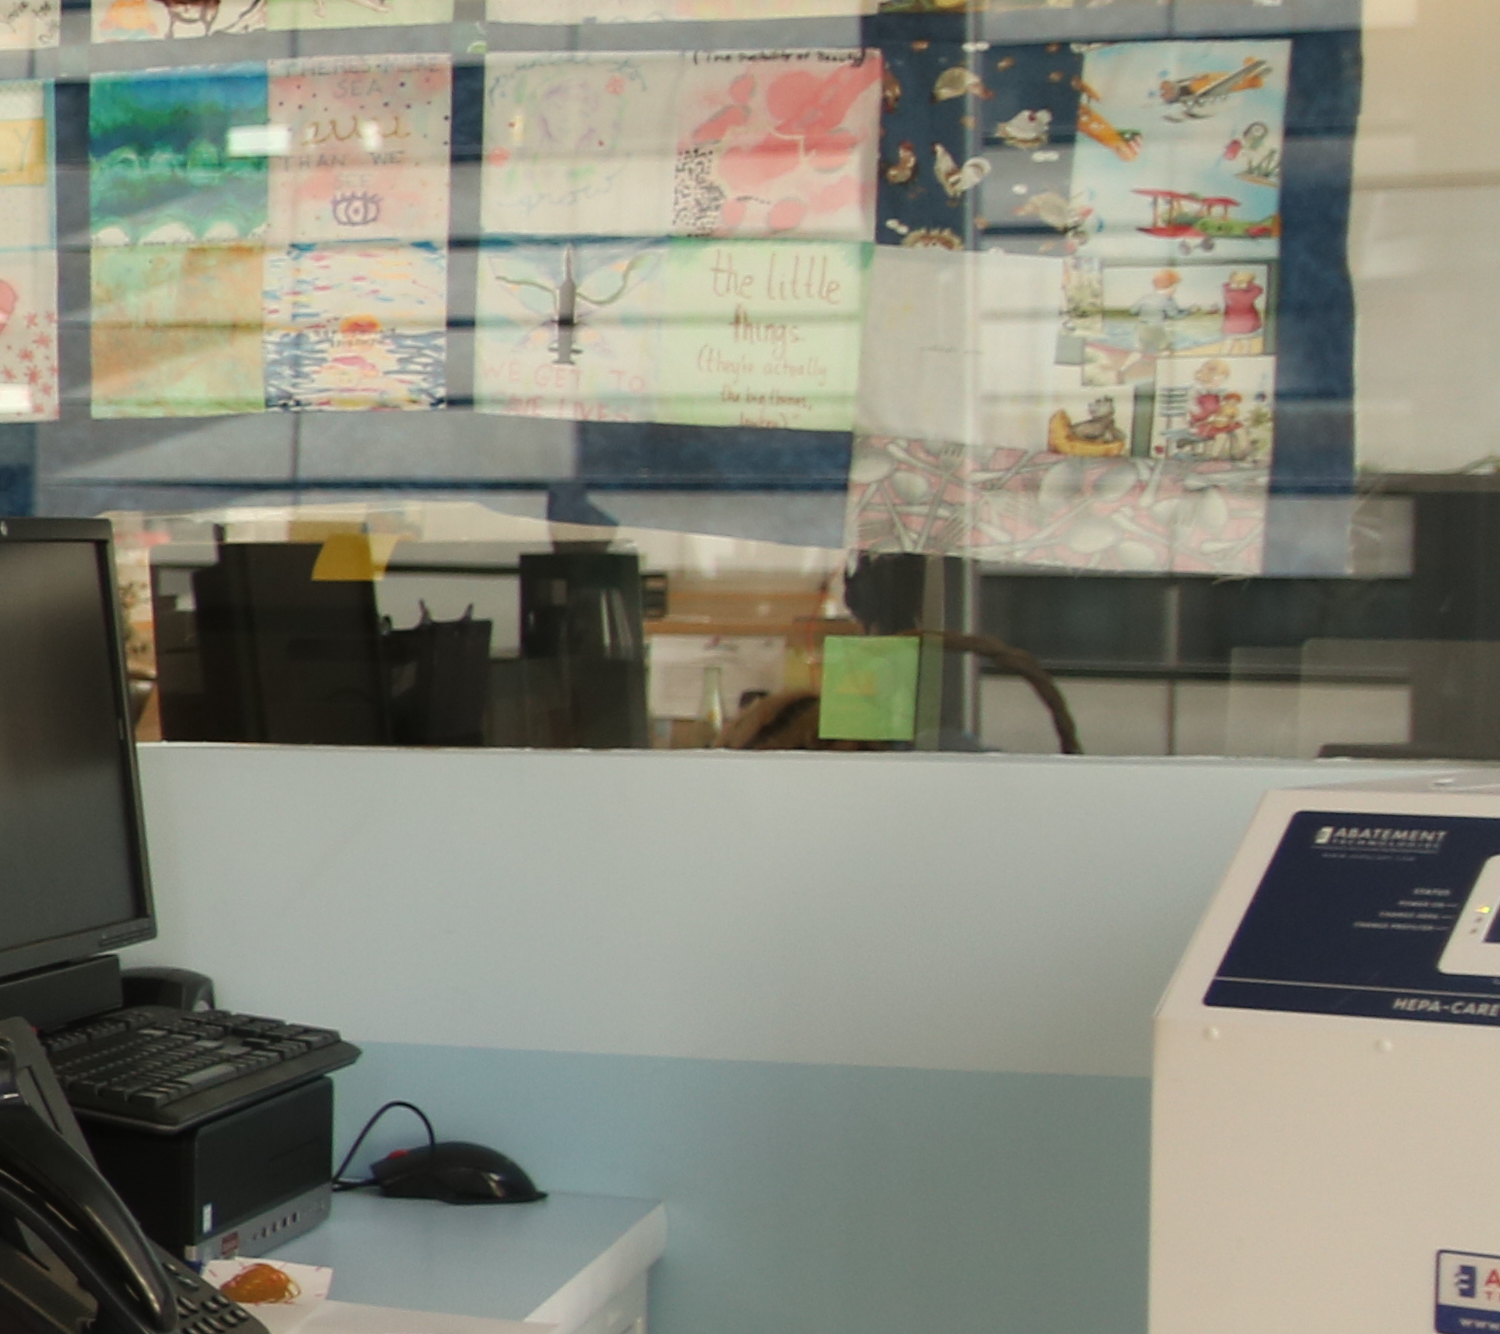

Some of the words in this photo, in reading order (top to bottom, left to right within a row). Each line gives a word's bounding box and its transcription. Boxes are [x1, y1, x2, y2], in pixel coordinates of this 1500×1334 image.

[710, 250, 754, 299] the
[766, 251, 840, 305] little
[1334, 827, 1448, 842] ABATEMENT
